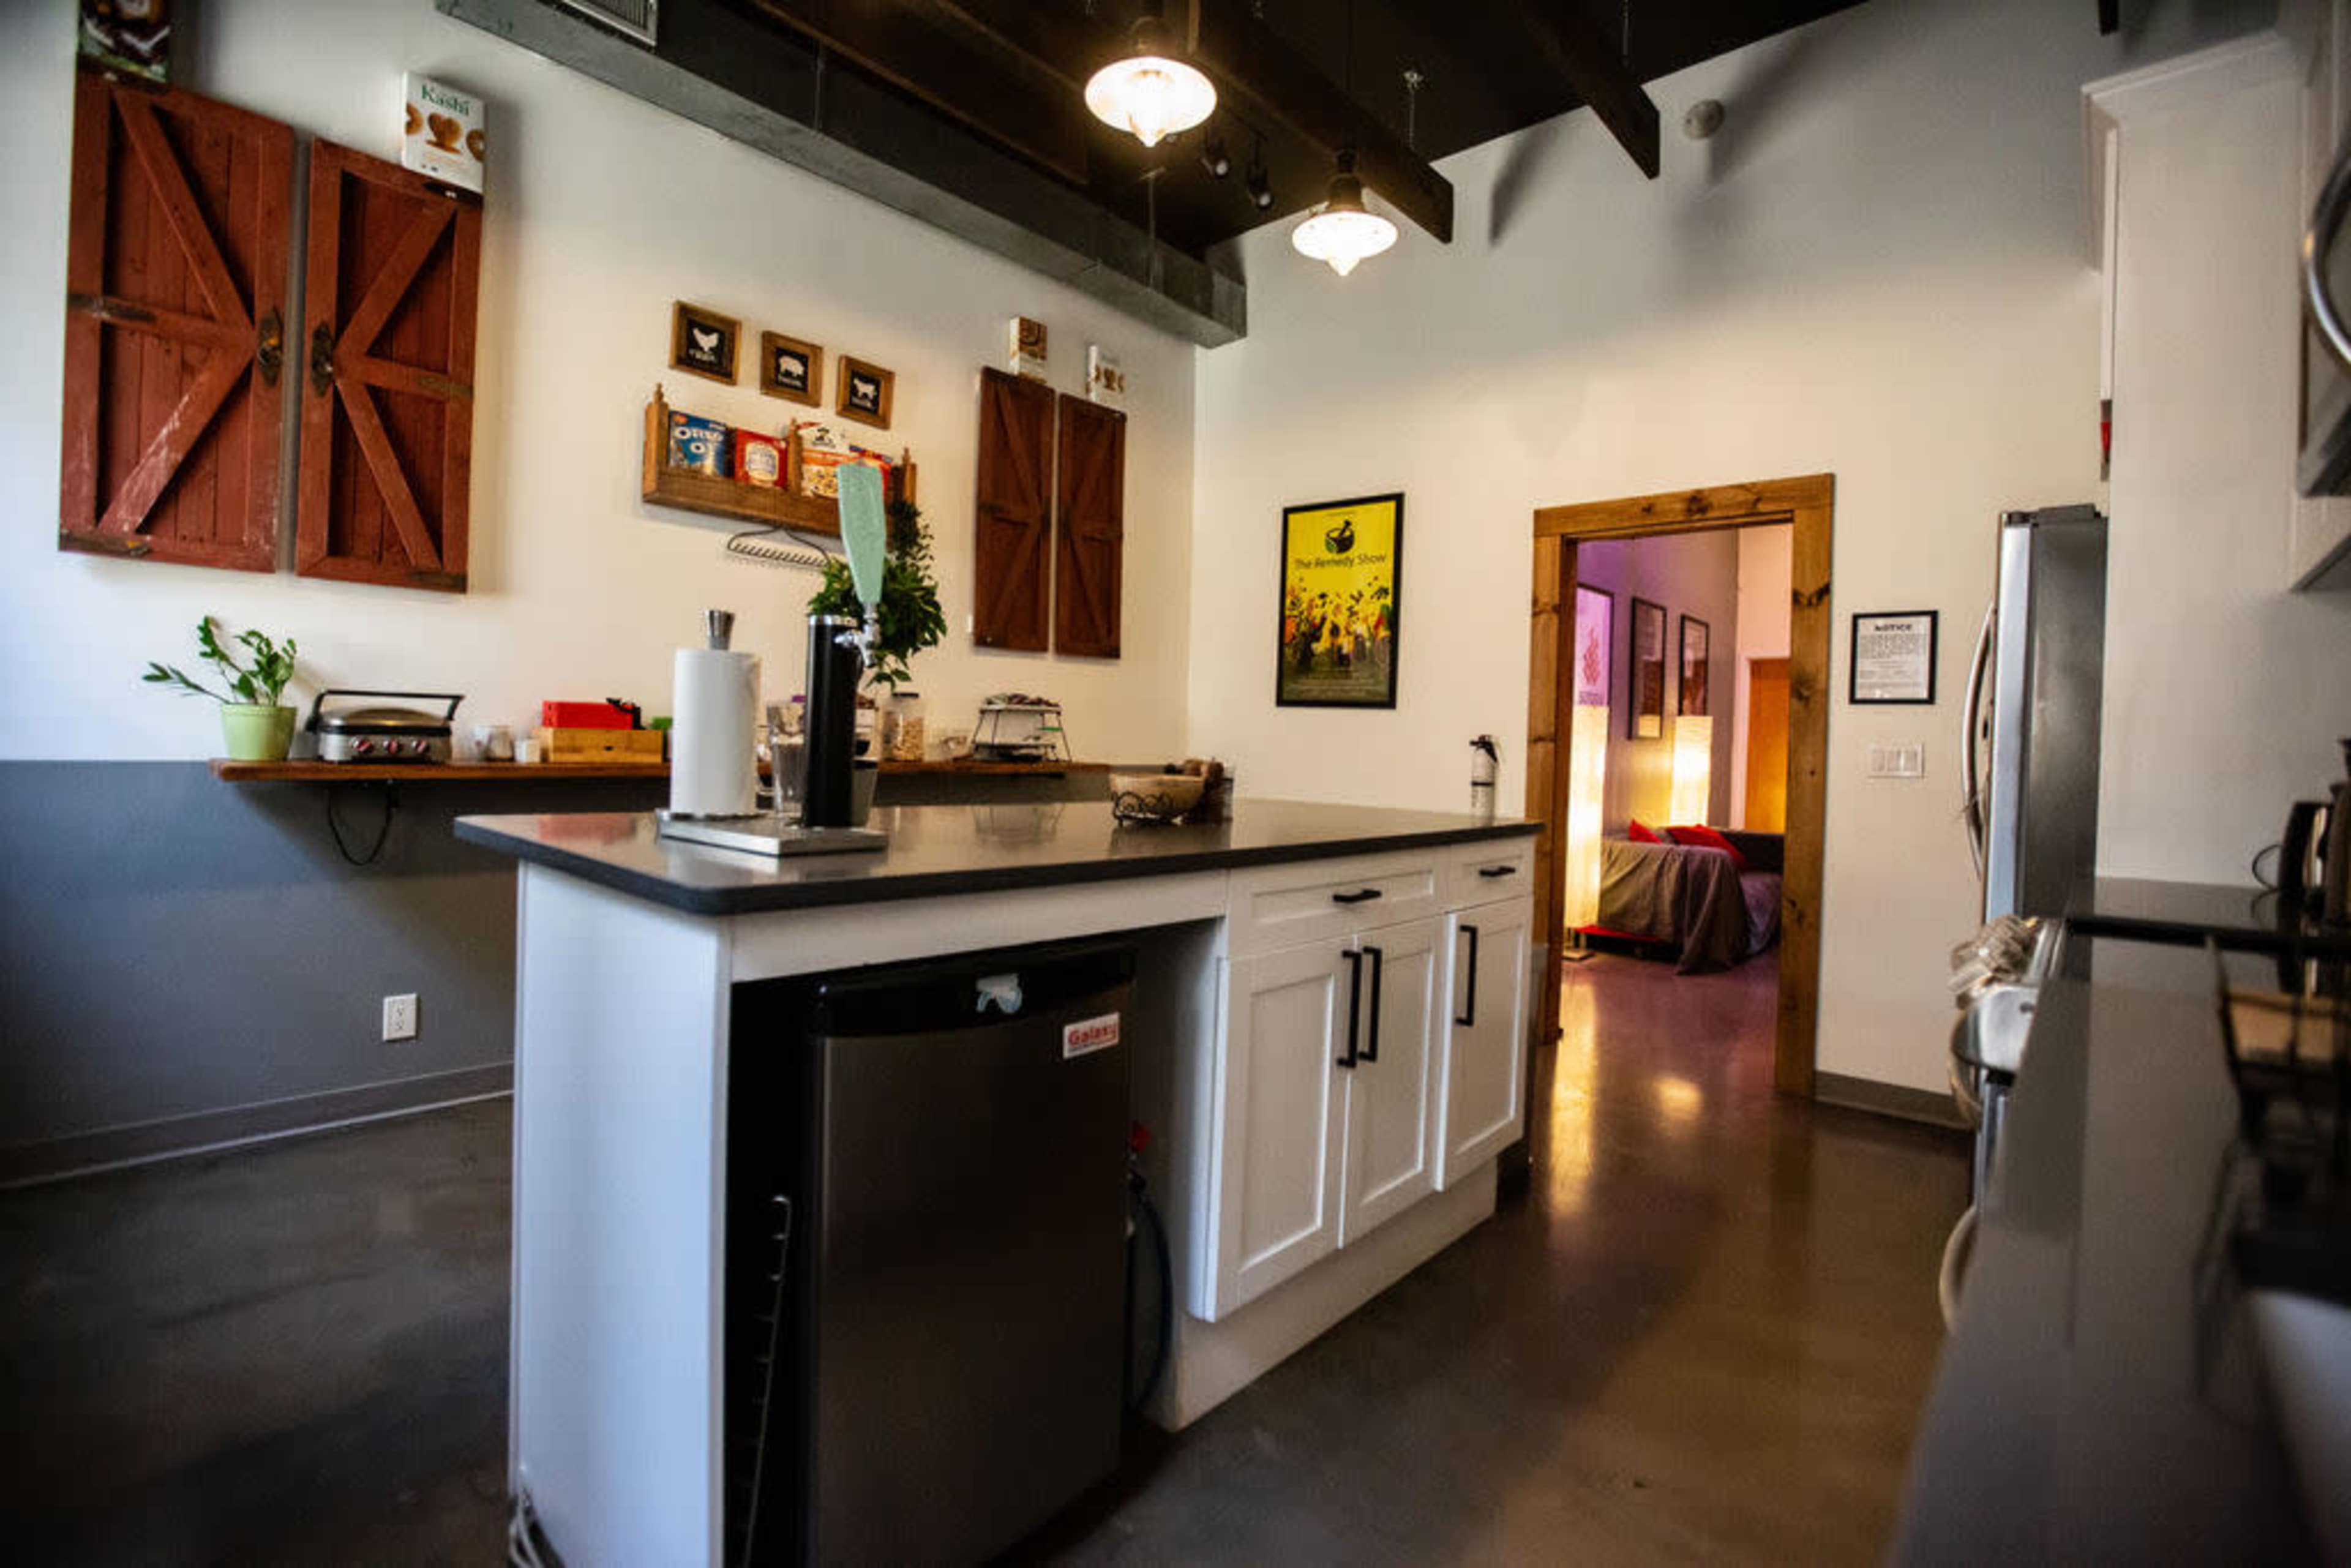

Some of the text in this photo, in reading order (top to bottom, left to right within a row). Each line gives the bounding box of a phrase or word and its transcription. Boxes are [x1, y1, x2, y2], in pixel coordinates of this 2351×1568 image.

[421, 84, 470, 116] Kashi
[1295, 553, 1387, 571] The Remedy Show
